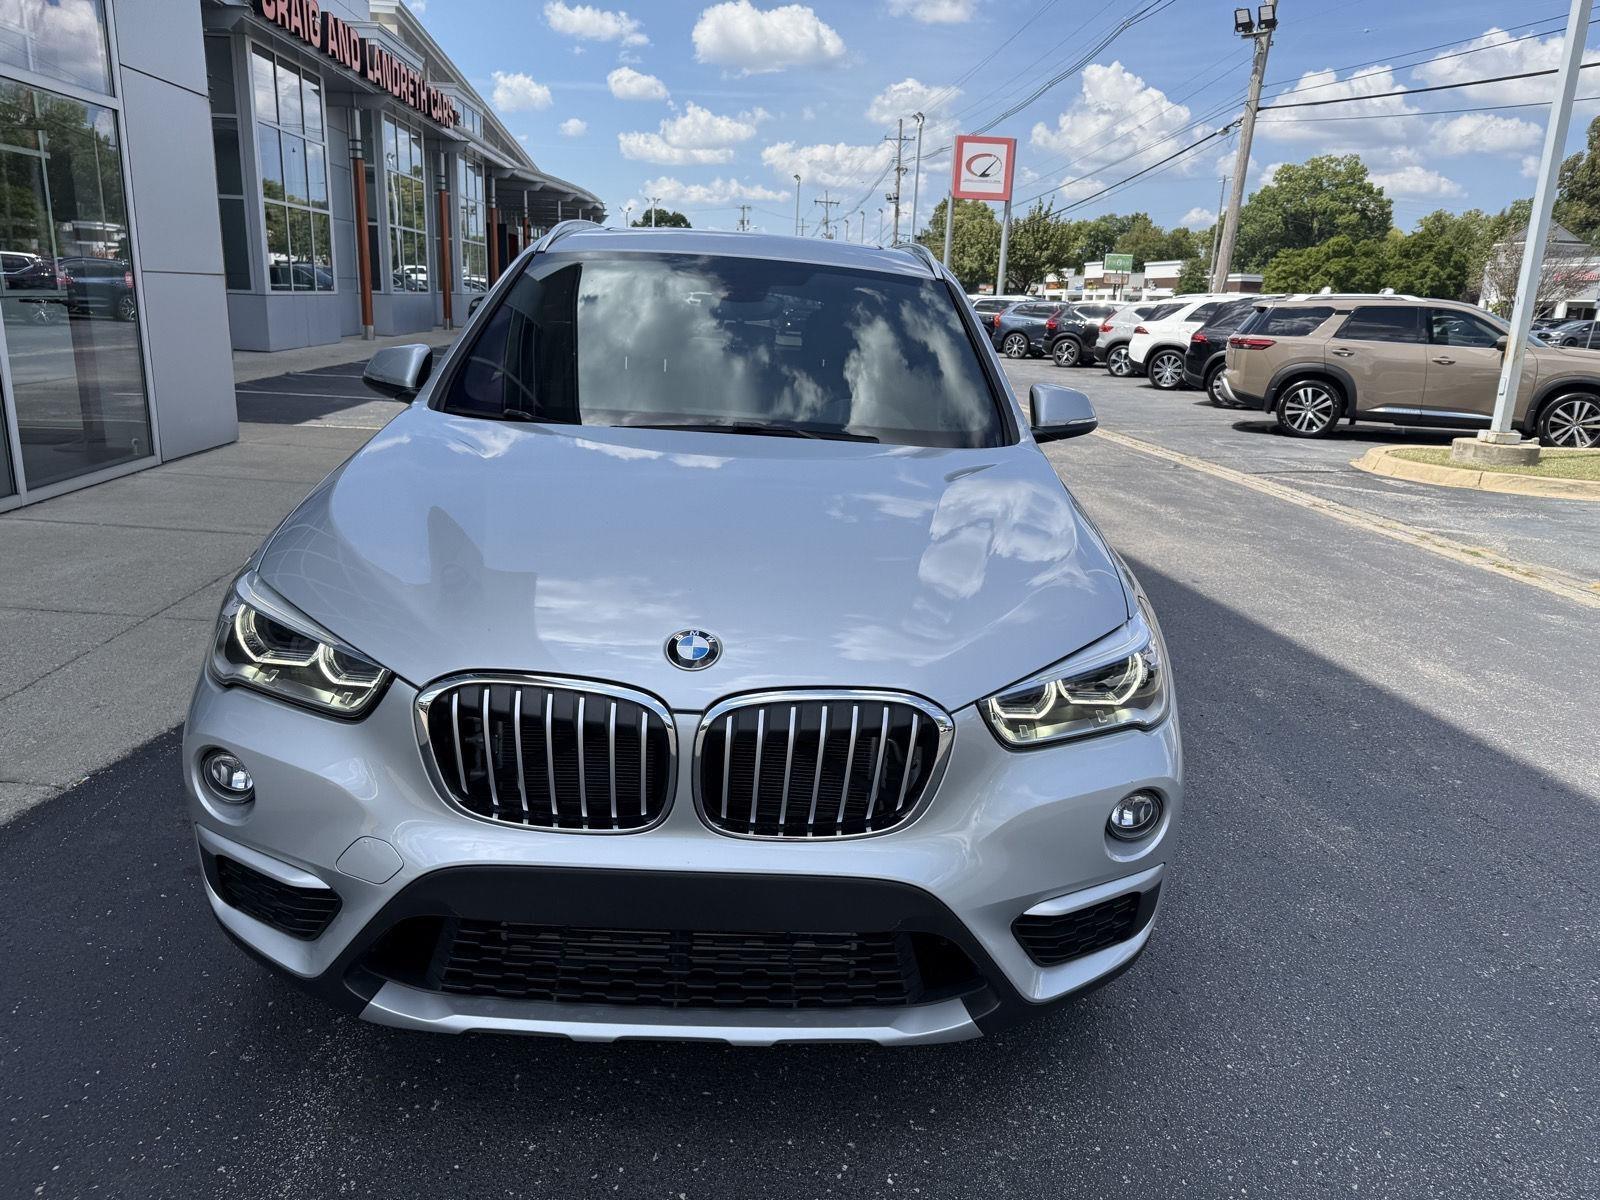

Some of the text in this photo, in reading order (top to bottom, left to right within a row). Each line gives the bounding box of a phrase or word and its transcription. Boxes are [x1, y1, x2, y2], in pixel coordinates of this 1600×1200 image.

[328, 13, 360, 72] AND
[366, 39, 428, 114] LANDRETH
[431, 86, 454, 128] CARS
[674, 631, 716, 642] BMW
